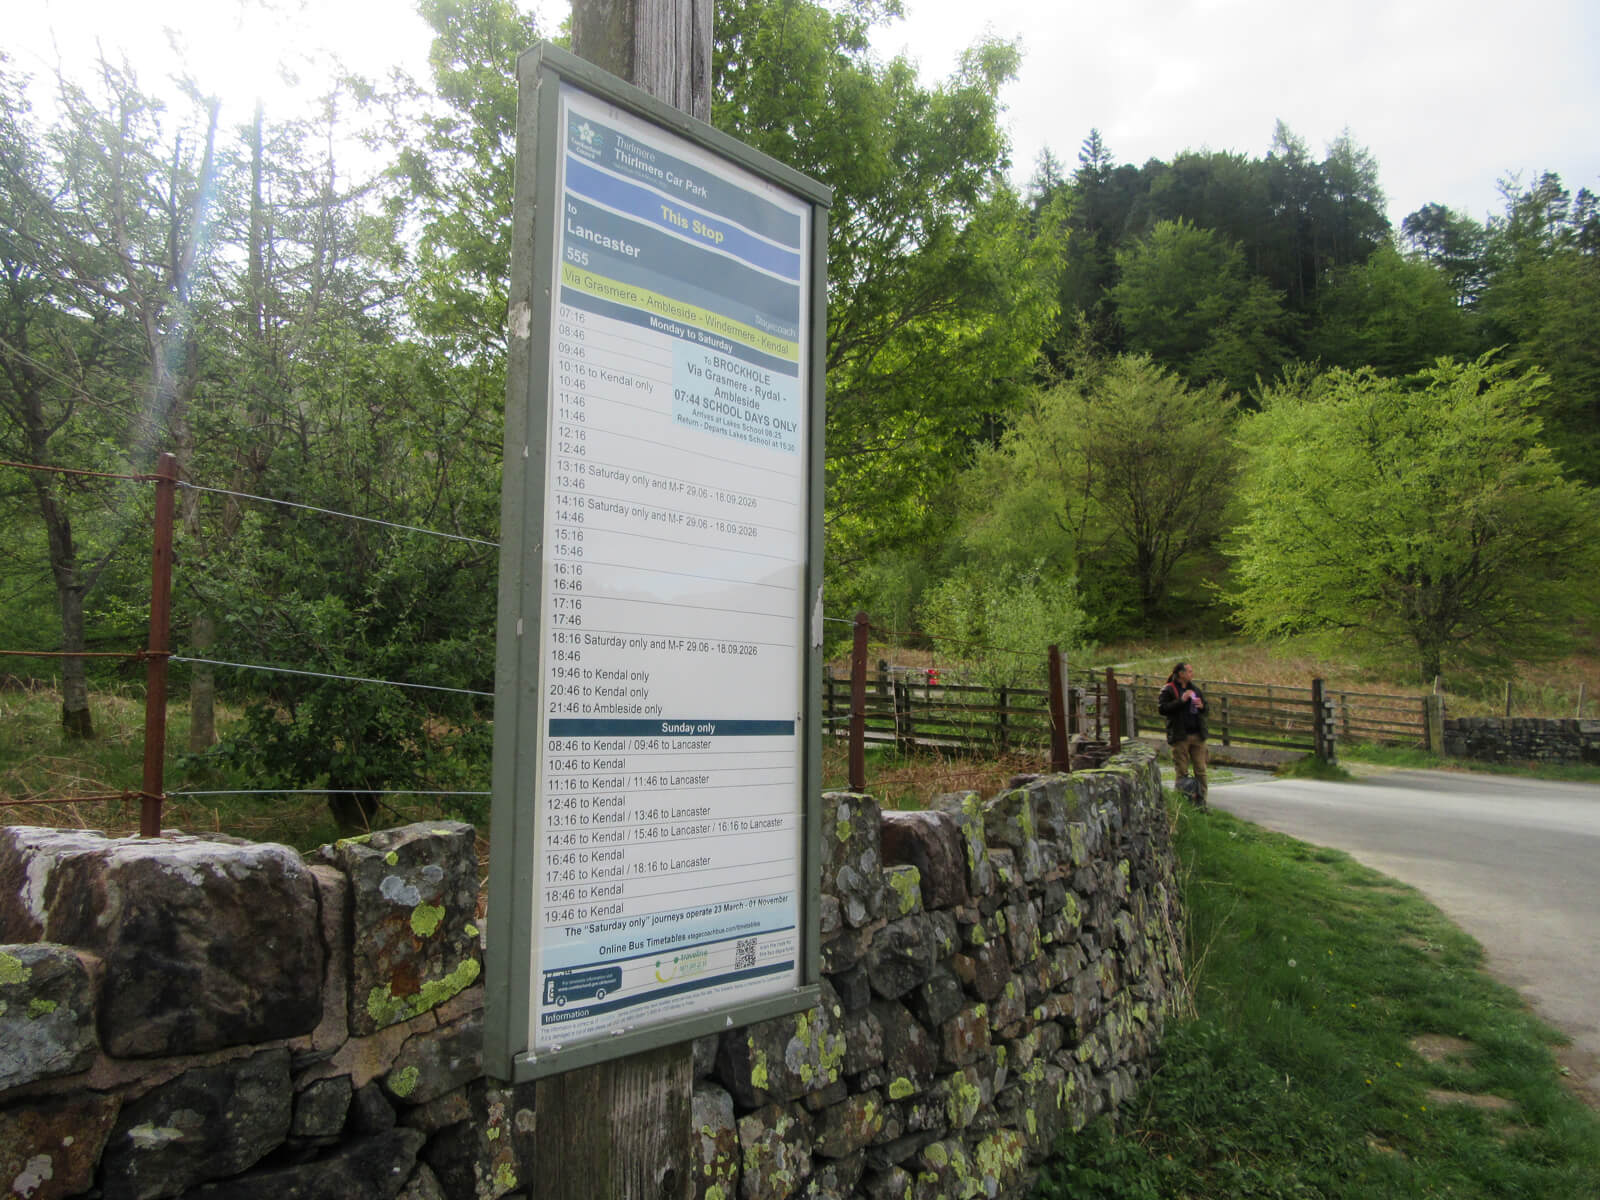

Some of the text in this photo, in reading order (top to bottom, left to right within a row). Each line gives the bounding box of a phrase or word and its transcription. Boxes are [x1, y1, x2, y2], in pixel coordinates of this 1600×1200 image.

[615, 148, 663, 178] Thirlmere
[666, 172, 683, 186] Car
[686, 181, 708, 198] Park
[568, 202, 577, 215] to
[661, 205, 724, 244] This Stop
[568, 218, 640, 258] Lancaster
[567, 247, 589, 266] 555
[560, 307, 584, 323] 07:16
[565, 269, 788, 354] Via Grasmere Ambleside Windermere Kendal
[559, 325, 584, 340] 08:46
[650, 316, 733, 354] Monday to Saturday
[558, 342, 585, 358] 09:46
[560, 360, 654, 394] 10:16 to Kendal only
[704, 356, 770, 386] To BROCKHOLE
[560, 376, 586, 390] 10:46
[688, 362, 780, 402] Via Grasmere Rydal
[714, 387, 760, 410] Ambleside
[560, 408, 586, 422] 11:46
[674, 389, 797, 432] 07:44 SCHOOL DAYS ONLY
[692, 409, 714, 421] Arrives
[716, 415, 722, 424] at
[742, 422, 764, 435] School
[558, 426, 586, 440] 12:16
[677, 414, 698, 427] Return
[704, 422, 727, 436] Departs
[729, 429, 747, 440] Lakes
[749, 434, 770, 447] School
[558, 442, 586, 456] 12:46
[556, 476, 585, 489] 13:46
[557, 460, 708, 498] 13:16 Saturday only and M-F 29.06
[555, 510, 584, 524] 14:46
[556, 495, 584, 508] 14:16
[588, 499, 630, 516] Saturday
[632, 506, 649, 520] only
[651, 510, 666, 522] and
[668, 514, 683, 524] M-F
[686, 516, 708, 529] 29.06
[555, 528, 584, 541] 15:16
[554, 544, 583, 556] 15:46
[554, 563, 582, 576] 16:16
[554, 579, 582, 591] 16:46
[552, 598, 582, 610] 17:16
[552, 614, 582, 626] 17:46
[552, 632, 758, 656] 18:16 Saturday only and M-F 29.06 18.09.2026
[552, 650, 580, 661] 18:46
[551, 668, 649, 682] 19:46 to Kendal only
[550, 684, 648, 700] 20:46 to Kendal only
[550, 702, 662, 716] 21:46 to Ambleside only
[662, 722, 716, 735] Sunday only
[548, 740, 711, 752] 08:46 to Kendal 09:46 to Lancaster
[549, 758, 626, 770] 10:46 to Kendal
[548, 775, 709, 790] 11:16 to Kendal 11:46 to Lancaster
[548, 796, 625, 810] 12:46 to Kendal
[548, 807, 710, 826] 13:16 to Kendal 13:46 to Lancaster
[548, 818, 783, 846] 14:46 to Kendal 15:46 to Lancaster 16:16 to Lancaster
[546, 849, 624, 866] 16:46 to Kendal
[546, 856, 711, 882] 17:46 to Kendal 18:16 to Lancaster
[546, 884, 624, 902] 18:46 to Kendal
[545, 903, 624, 922] 19:46 to Kendal
[565, 928, 582, 937] The
[652, 912, 684, 926] journeys
[686, 908, 712, 920] operate
[714, 906, 721, 914] 23
[724, 902, 744, 912] March
[748, 900, 756, 908] 01
[758, 896, 788, 906] November
[600, 945, 626, 955] Online
[629, 942, 644, 950] Bus
[648, 934, 686, 947] Timetables
[545, 1009, 590, 1023] Information
